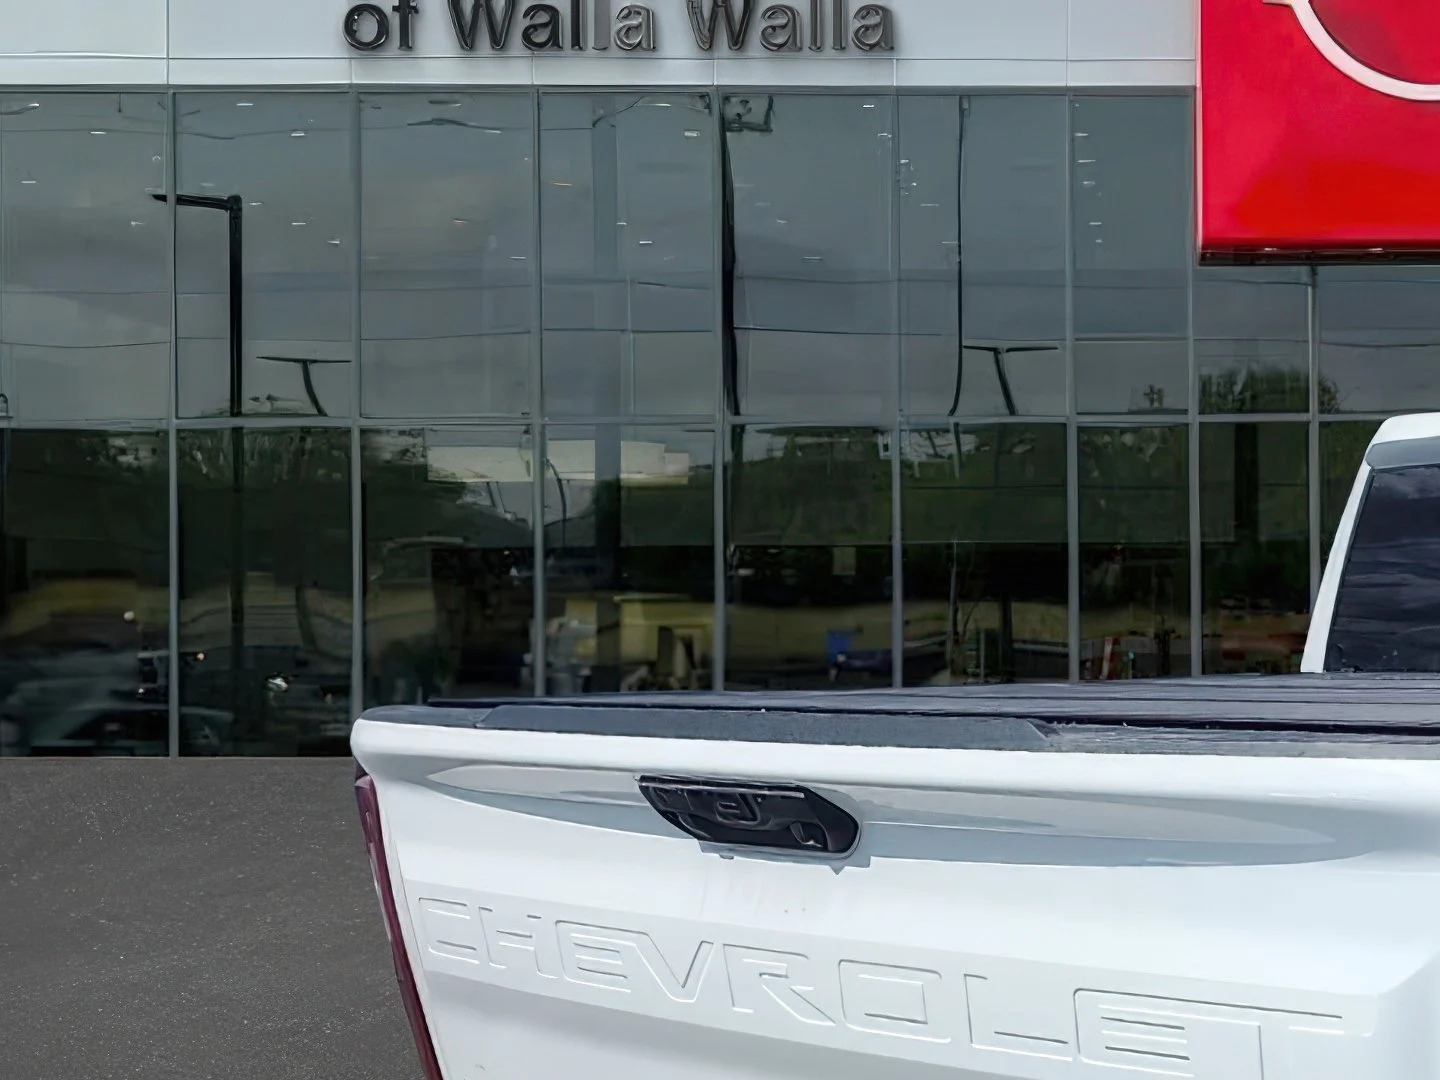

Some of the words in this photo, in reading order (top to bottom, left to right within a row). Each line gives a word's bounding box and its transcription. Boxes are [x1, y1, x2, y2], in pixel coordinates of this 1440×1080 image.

[344, 0, 419, 50] of
[447, 0, 656, 50] Walla
[687, 0, 895, 50] Walla
